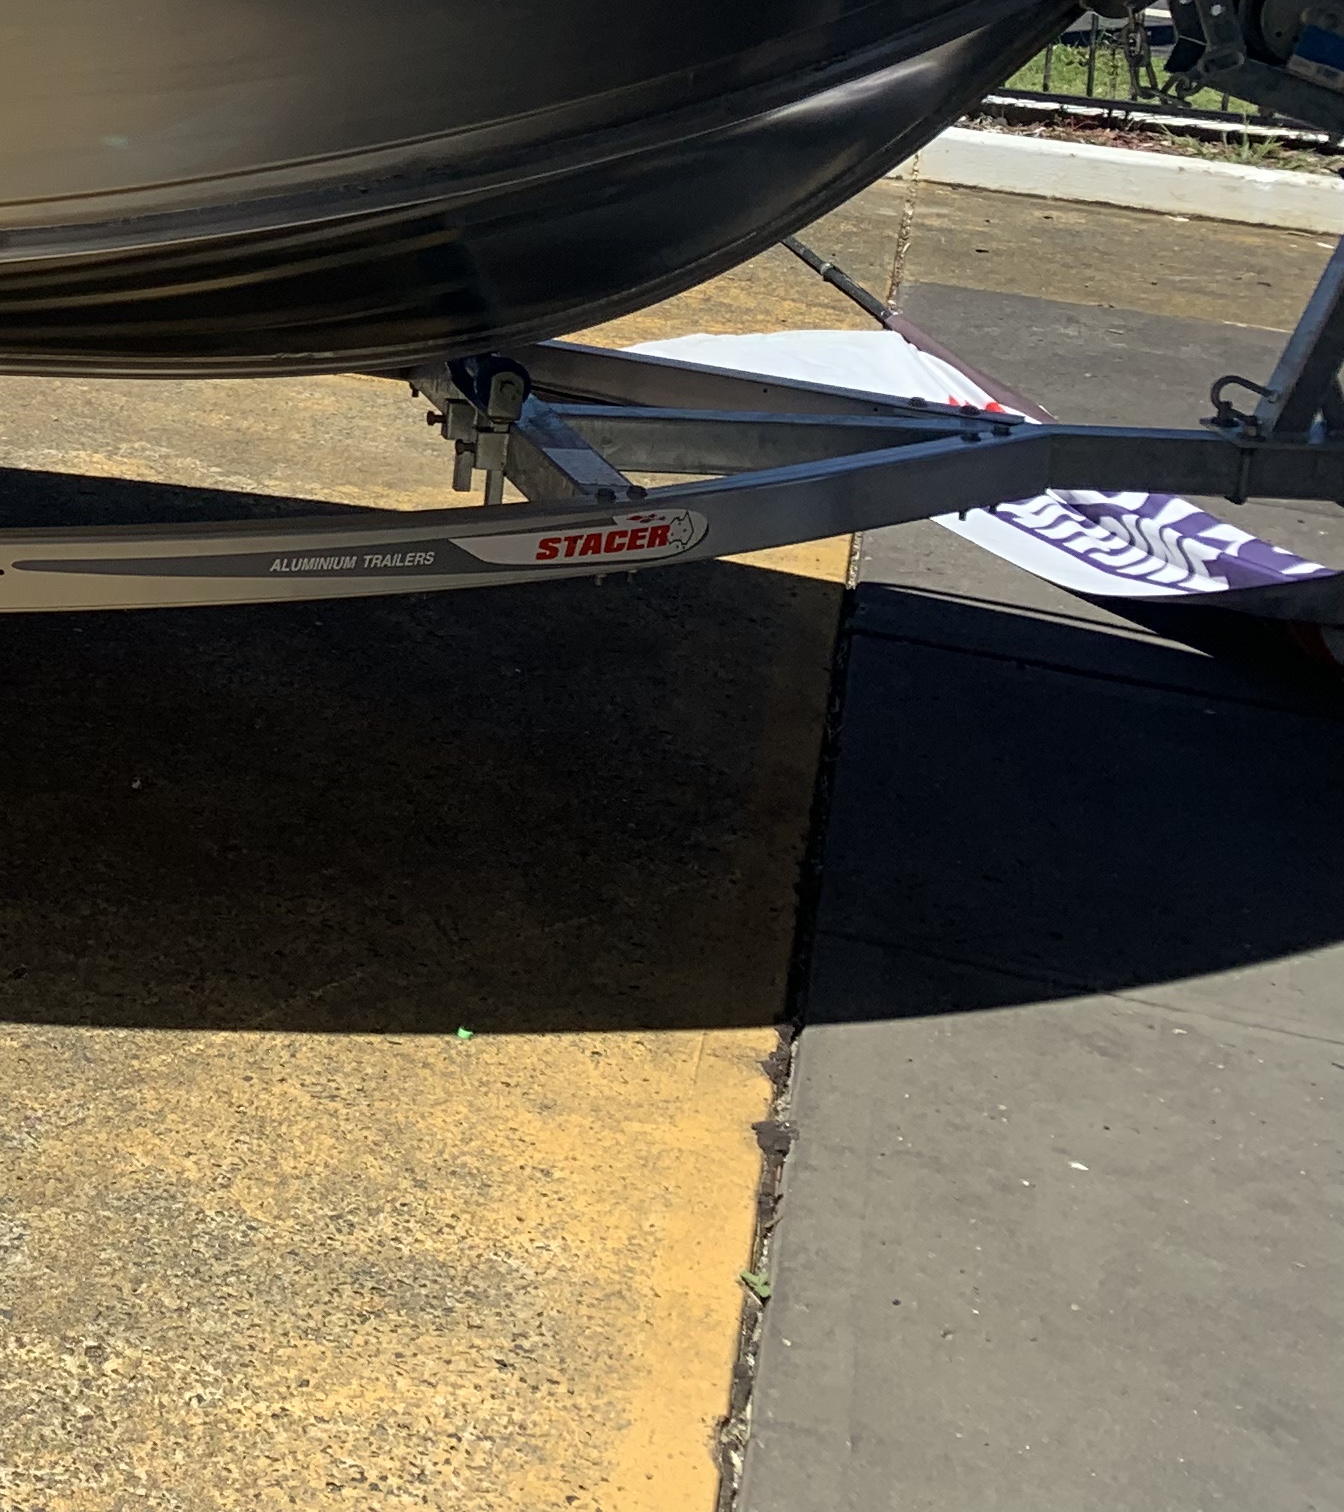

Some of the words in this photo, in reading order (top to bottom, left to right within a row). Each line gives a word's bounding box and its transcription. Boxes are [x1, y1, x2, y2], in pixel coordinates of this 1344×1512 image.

[534, 524, 672, 561] STACER
[269, 554, 358, 573] ALUMINIUM
[362, 551, 435, 570] TRAILERS
